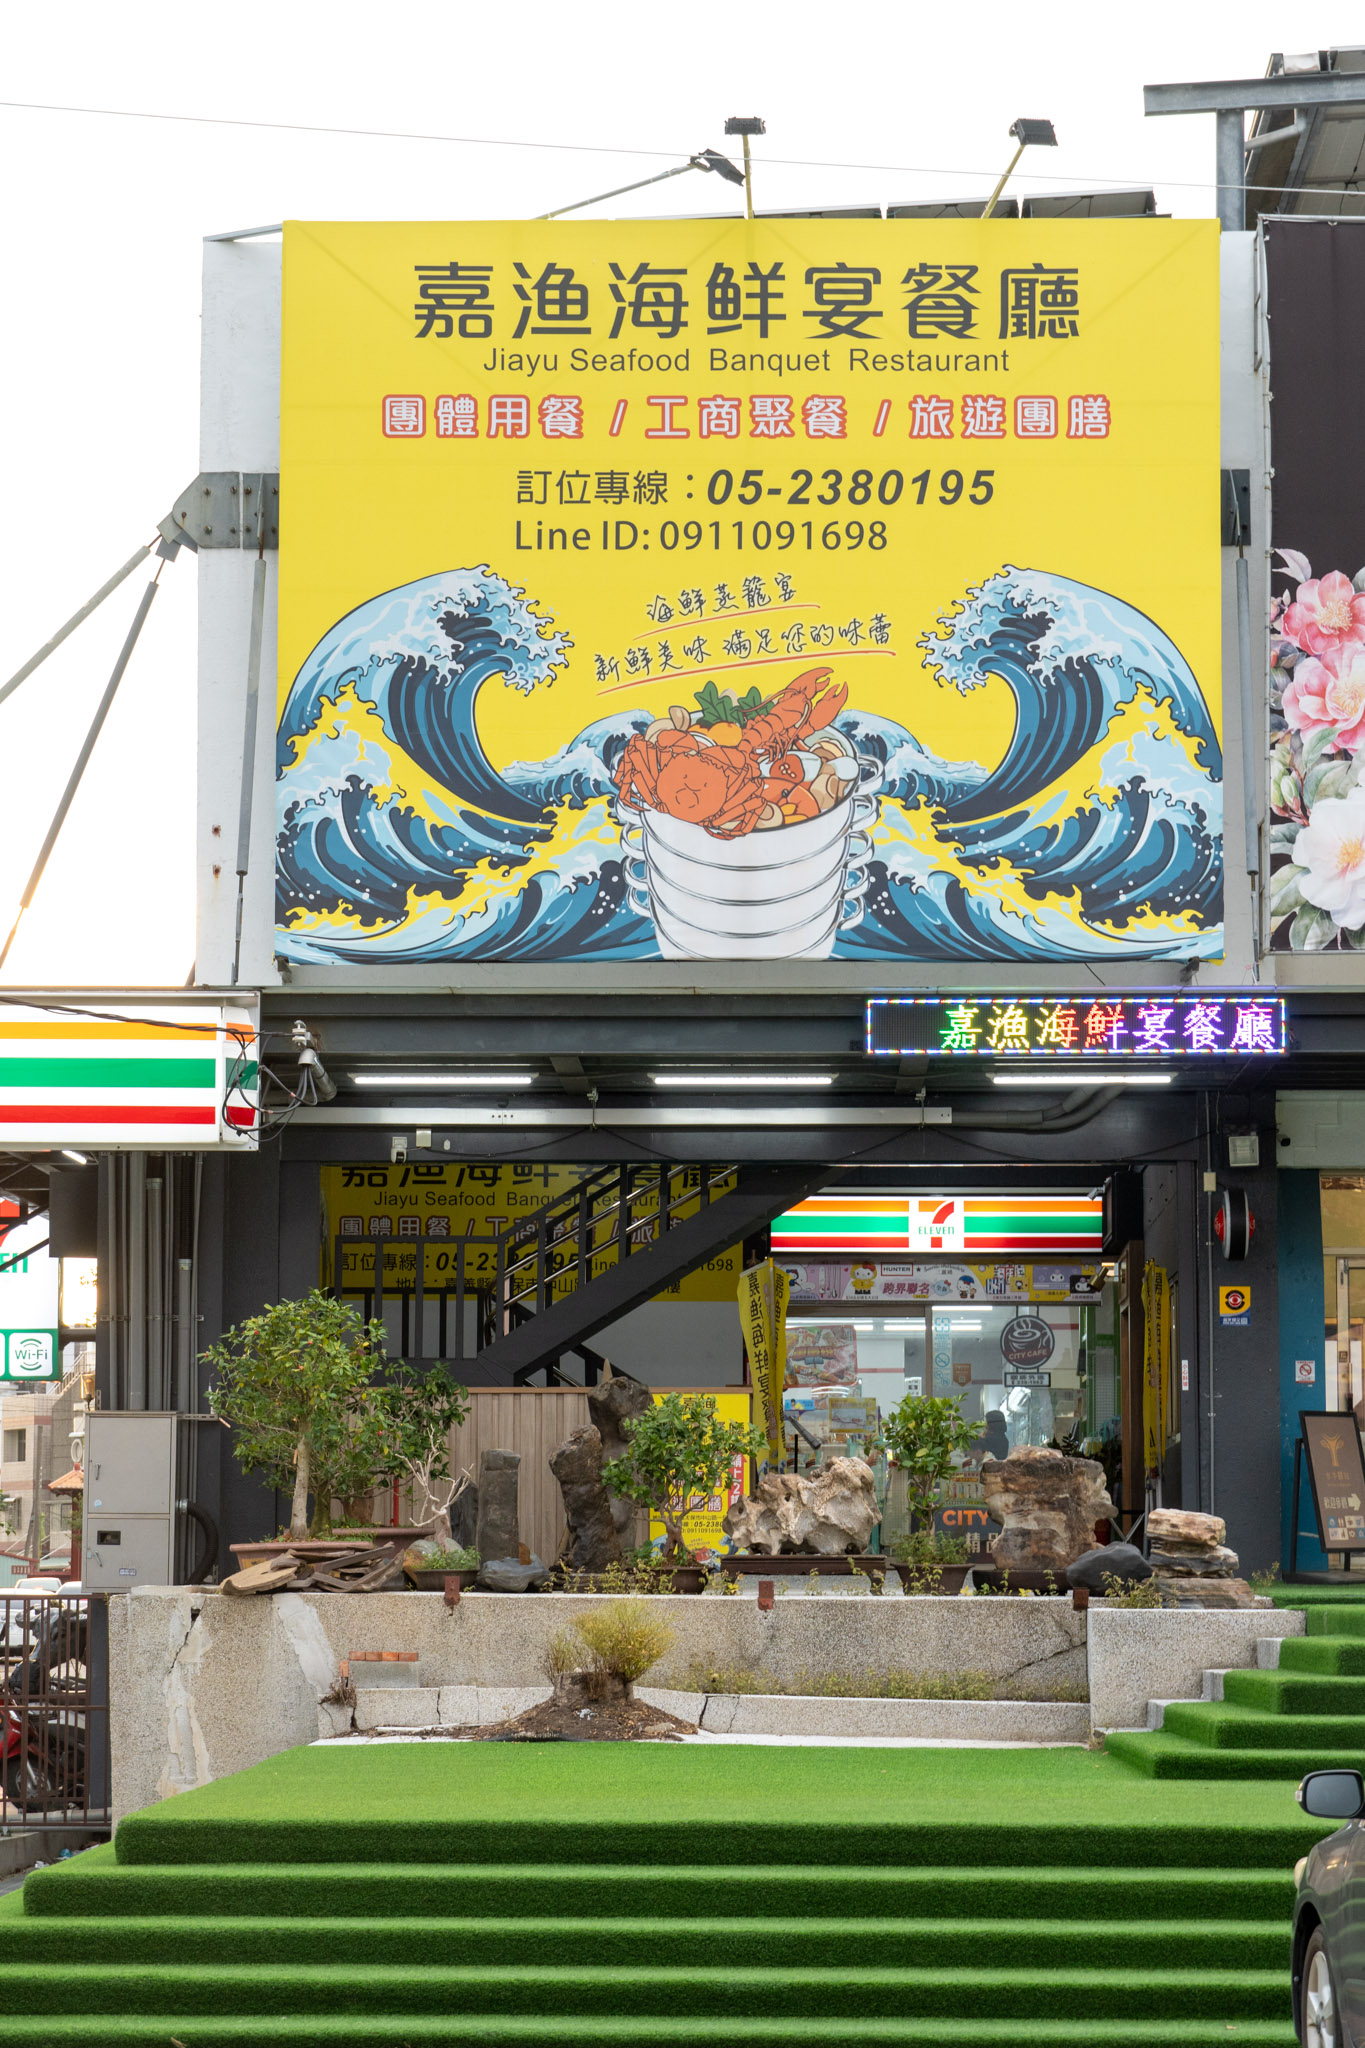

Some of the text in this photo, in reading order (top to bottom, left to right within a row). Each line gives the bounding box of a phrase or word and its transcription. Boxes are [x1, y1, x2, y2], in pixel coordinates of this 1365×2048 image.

[414, 262, 1080, 339] 嘉漁海鮮宴餐廳
[484, 349, 1009, 376] Jiayu Seafood Banquet Restaurant
[382, 394, 585, 439] 團體用餐
[644, 394, 848, 439] 工商聚餐
[908, 394, 1112, 439] 旅遊團膳
[707, 470, 995, 505] 05-2380195
[517, 521, 888, 550] Line ID: 0911091698
[938, 1004, 1276, 1049] 嘉漁海鮮宴餐廳
[374, 1191, 419, 1209] Jiayu
[425, 1191, 496, 1207] Seafood
[15, 1350, 48, 1360] Wi-Fi
[1009, 1349, 1048, 1360] CITY CAFE
[942, 1509, 989, 1526] CITY
